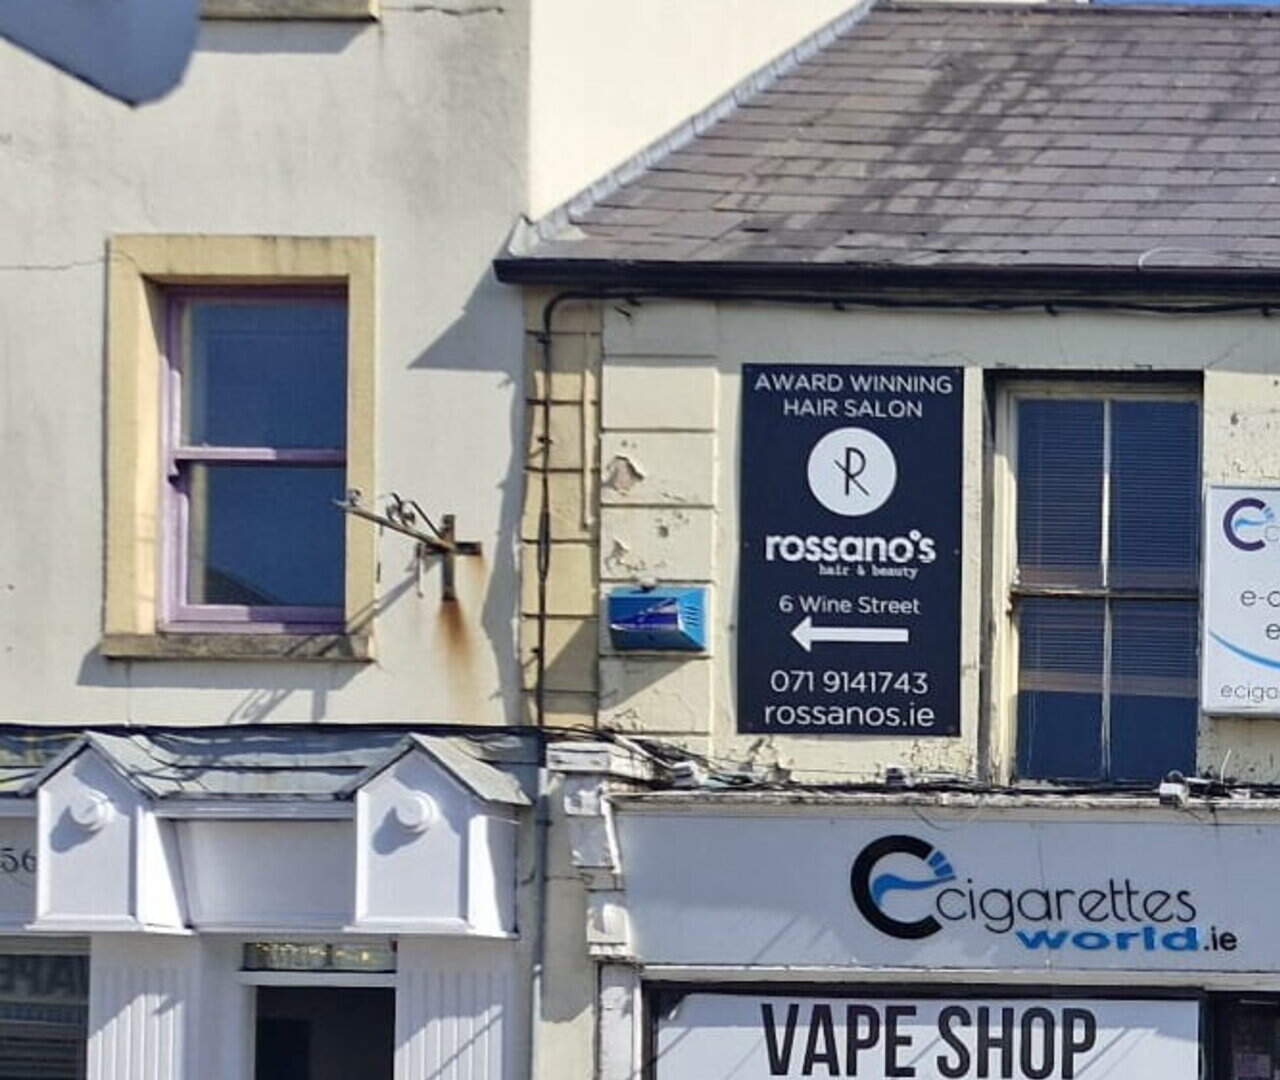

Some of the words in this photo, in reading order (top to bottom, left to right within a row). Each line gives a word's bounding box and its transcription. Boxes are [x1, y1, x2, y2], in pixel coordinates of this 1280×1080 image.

[754, 373, 843, 392] AWARD
[850, 375, 953, 395] WINNING
[783, 400, 838, 417] HAIR
[843, 400, 924, 419] SALON
[818, 564, 849, 577] hair
[871, 565, 919, 580] beauty
[779, 595, 793, 613] 6
[800, 595, 852, 613] Wine
[858, 596, 920, 615] Street
[770, 671, 815, 693] 071
[823, 671, 929, 695] 9141743
[764, 702, 935, 728] rossanos.ie
[1015, 926, 1239, 952] world.ie
[760, 1003, 918, 1078] VAPE
[936, 1005, 1097, 1080] SHOP
